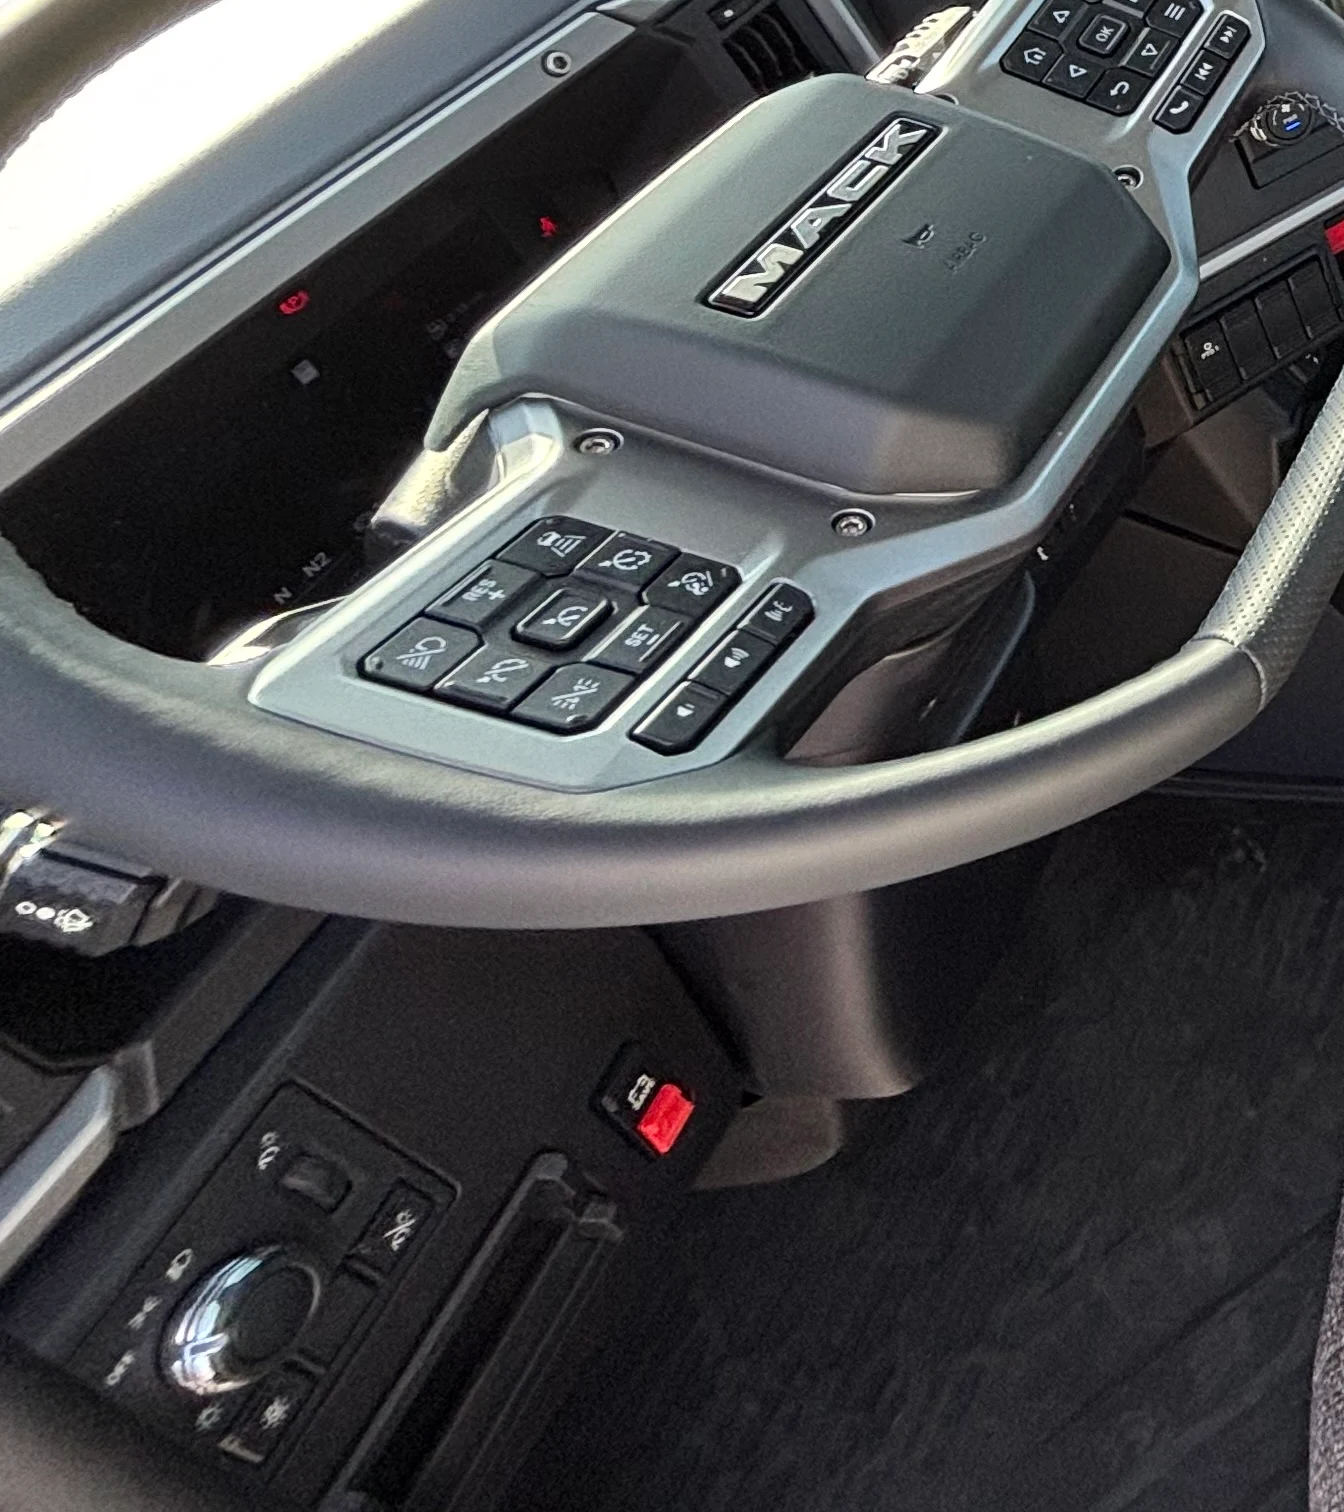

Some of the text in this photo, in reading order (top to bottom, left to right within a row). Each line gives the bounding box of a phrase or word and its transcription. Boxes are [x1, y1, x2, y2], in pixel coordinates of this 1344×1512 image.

[1095, 25, 1115, 43] OK
[721, 123, 928, 303] MACK
[461, 579, 497, 602] RES
[625, 623, 655, 648] SET
